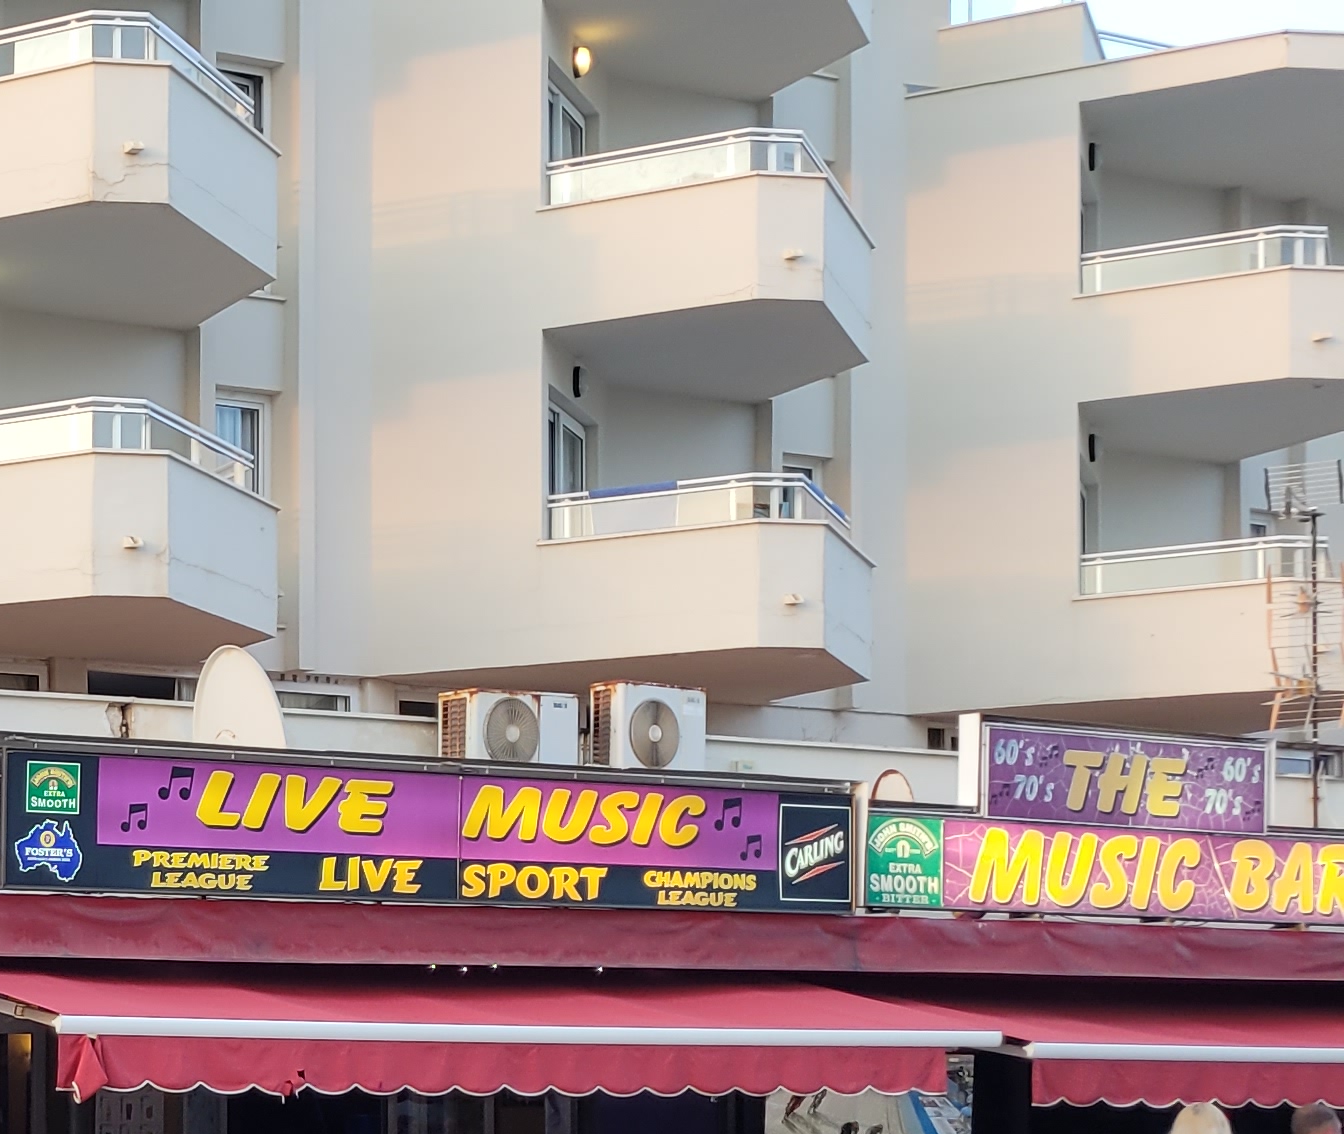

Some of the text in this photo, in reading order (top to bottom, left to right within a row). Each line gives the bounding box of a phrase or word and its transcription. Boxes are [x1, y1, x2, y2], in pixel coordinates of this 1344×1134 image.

[994, 739, 1261, 818] 60's THE 60's
[30, 796, 76, 809] SMOOTH
[1014, 775, 1243, 816] 70's 70's
[196, 771, 707, 848] LIVE MUSIC
[24, 847, 74, 858] FOSTER'S
[131, 849, 270, 871] PREMIERE
[784, 830, 845, 879] CARLING
[318, 855, 609, 901] LIVE SPORT
[888, 862, 922, 874] EXTRA
[968, 827, 1344, 915] MUSIC BAR
[150, 871, 254, 891] LEAGUE
[643, 870, 758, 892] CHAMPIONS
[869, 873, 939, 895] SMOOTH
[656, 890, 738, 908] LEAGUE
[881, 893, 929, 905] BITTER
